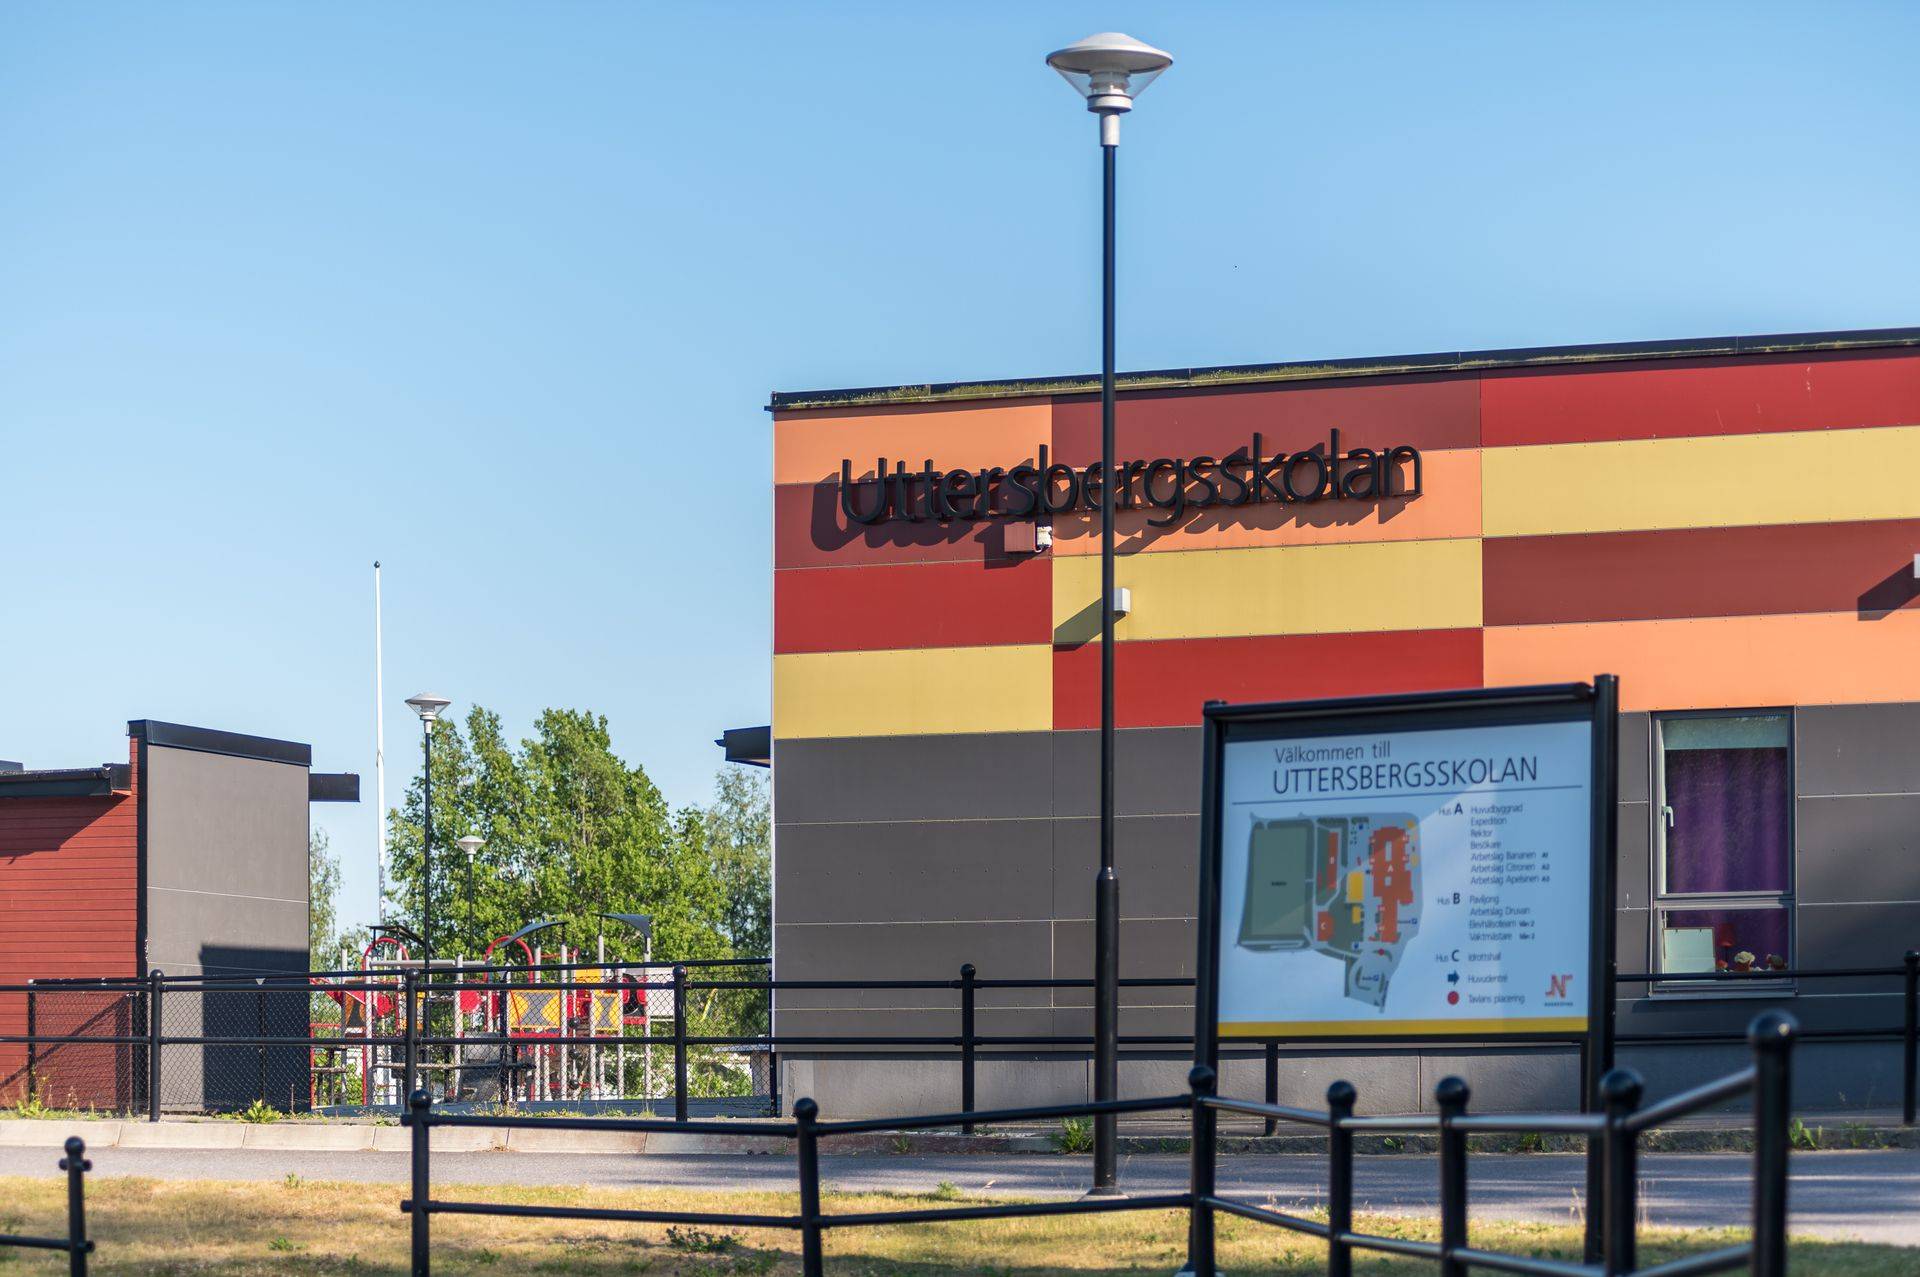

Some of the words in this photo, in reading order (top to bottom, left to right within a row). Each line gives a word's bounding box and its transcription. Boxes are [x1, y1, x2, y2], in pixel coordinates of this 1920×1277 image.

[842, 428, 1422, 528] Uttersbergsskolan
[1275, 745, 1364, 764] Välkommen
[1372, 741, 1391, 759] till
[1273, 756, 1537, 795] UTTERSBERGSSKOLAN
[1455, 803, 1463, 815] A
[1471, 817, 1507, 827] Expedition
[1471, 853, 1504, 862] Arbetslag
[1471, 864, 1504, 874] Arbetslag
[1471, 876, 1504, 886] Arbetslag
[1453, 892, 1461, 904] B
[1470, 907, 1503, 917] Arbetslag
[1451, 949, 1460, 962] C
